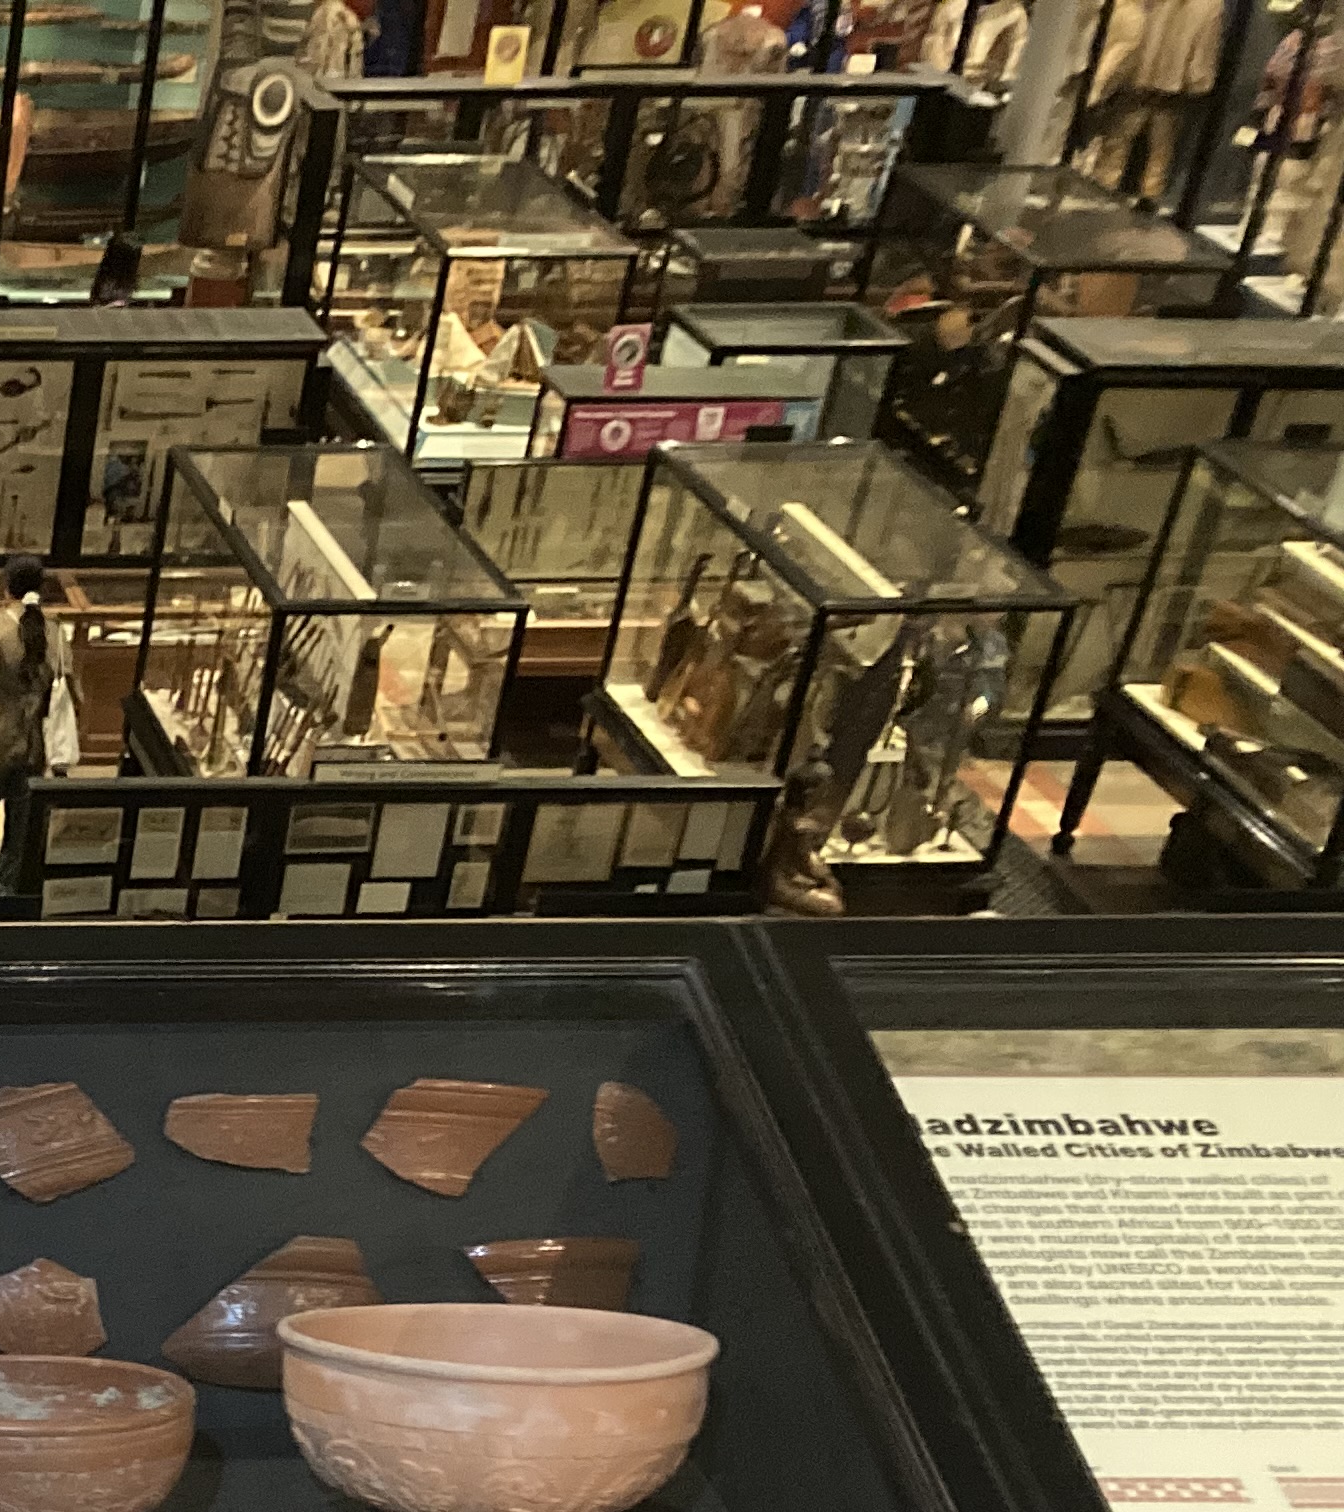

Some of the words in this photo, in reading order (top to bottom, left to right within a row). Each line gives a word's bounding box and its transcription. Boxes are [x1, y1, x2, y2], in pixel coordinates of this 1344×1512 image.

[914, 1113, 1219, 1137] adzimbahwe
[956, 1143, 1057, 1157] Walled
[1064, 1143, 1153, 1157] Cities
[1159, 1143, 1188, 1157] of
